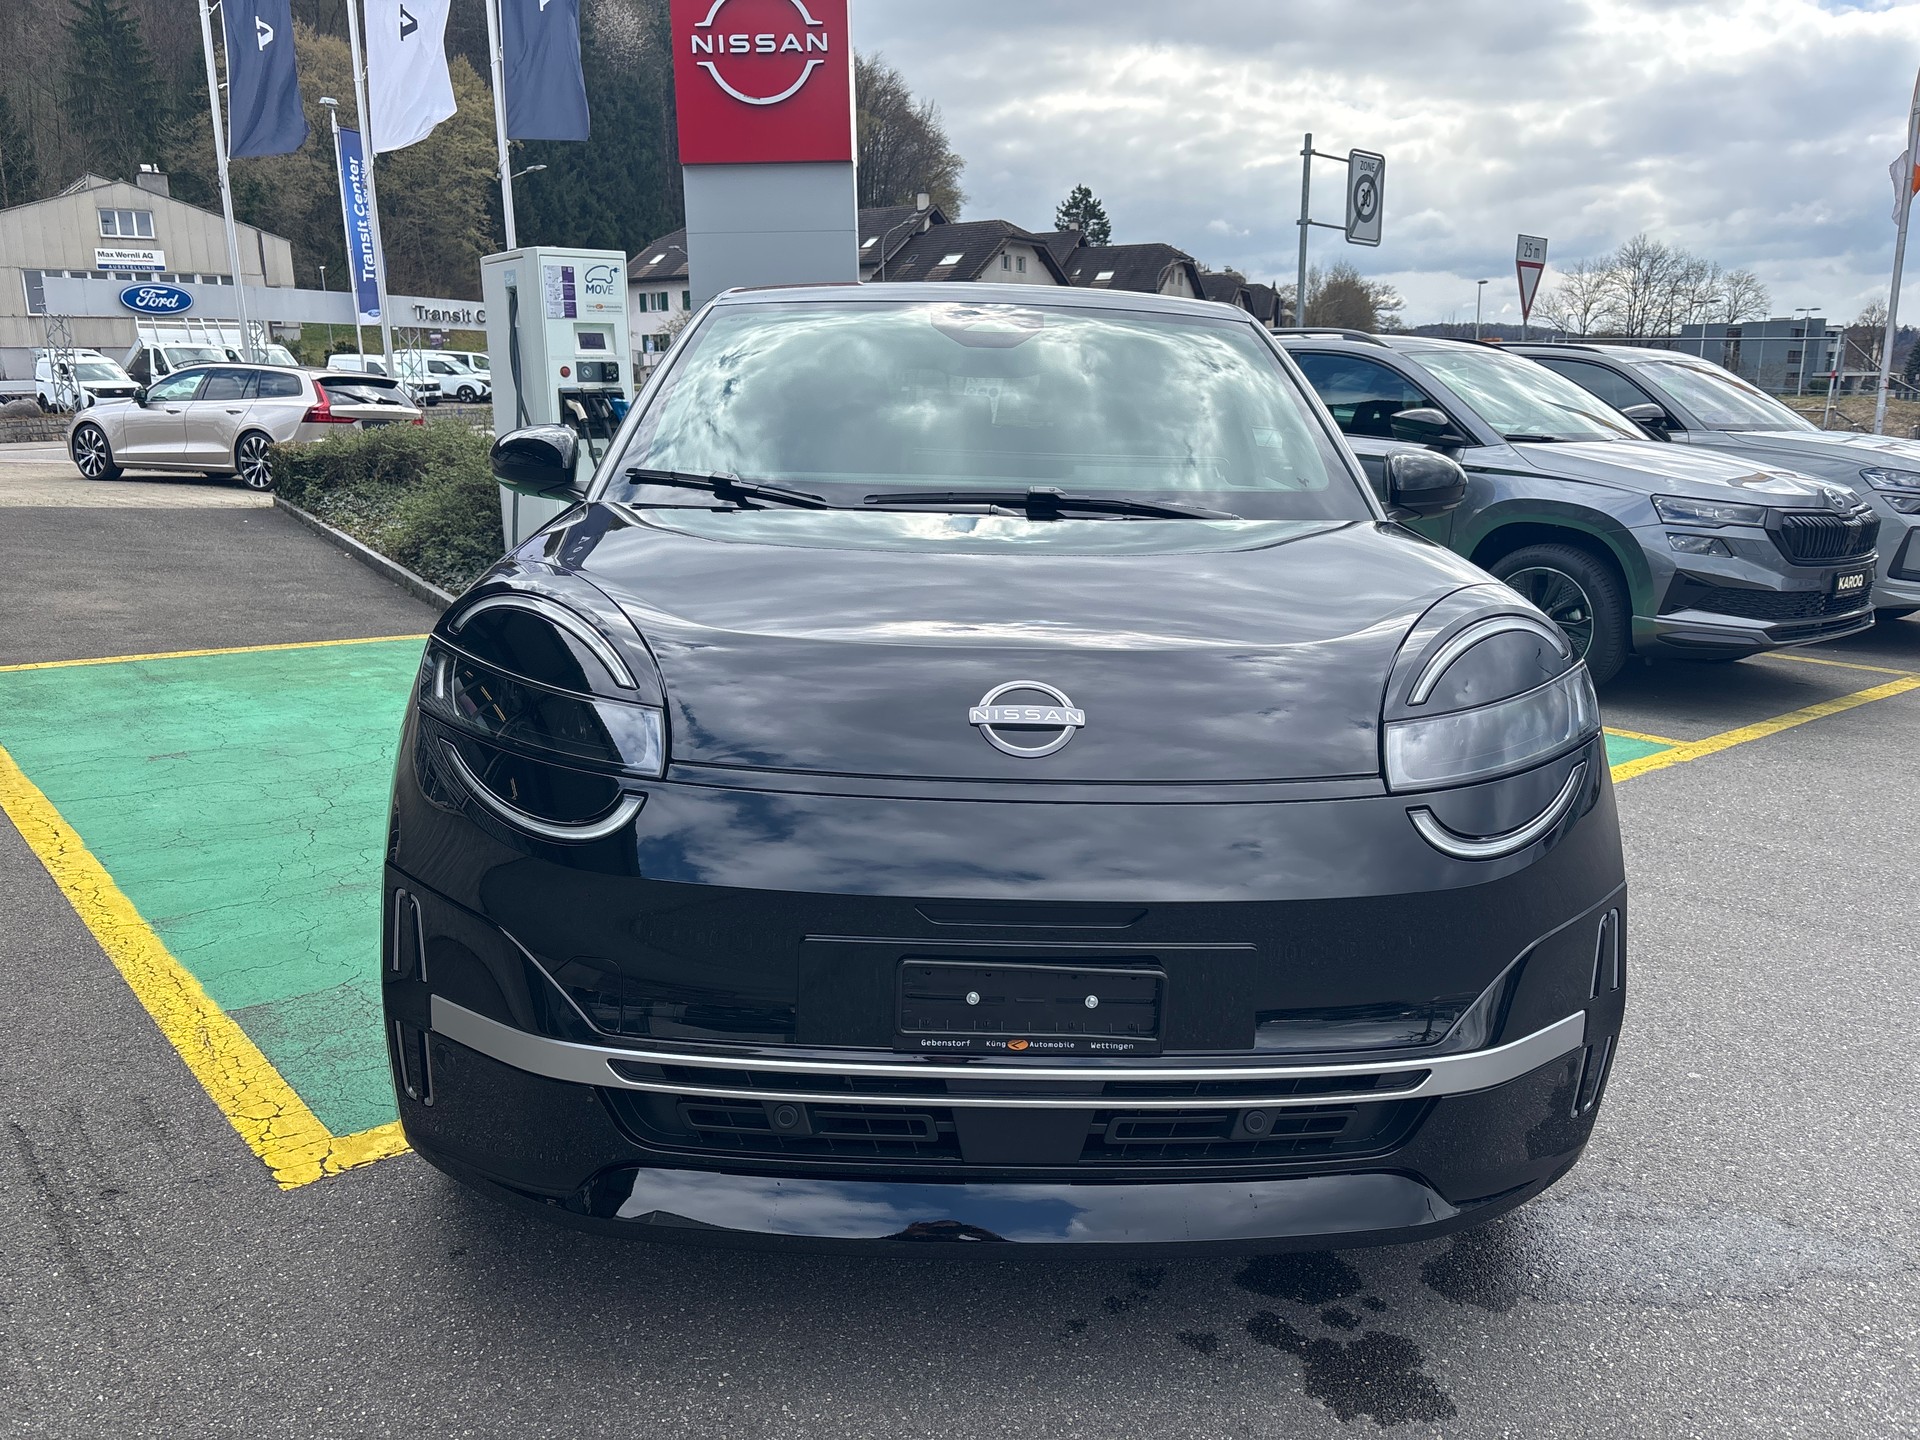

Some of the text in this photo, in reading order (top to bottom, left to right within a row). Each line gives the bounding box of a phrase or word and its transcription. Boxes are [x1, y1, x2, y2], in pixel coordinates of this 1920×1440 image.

[691, 32, 828, 54] NISSAN
[1360, 160, 1375, 172] ZONE
[349, 156, 365, 217] Center
[1360, 188, 1371, 207] 30
[356, 219, 376, 282] Transit
[1523, 242, 1540, 259] 25 m
[135, 288, 179, 308] Ford
[585, 284, 614, 295] MOVE
[414, 304, 472, 323] Transit
[1838, 574, 1864, 590] KAROQ
[973, 708, 1082, 723] NISSAN
[920, 1038, 1134, 1050] Gebenstorf Küng Automobile Wettingen
